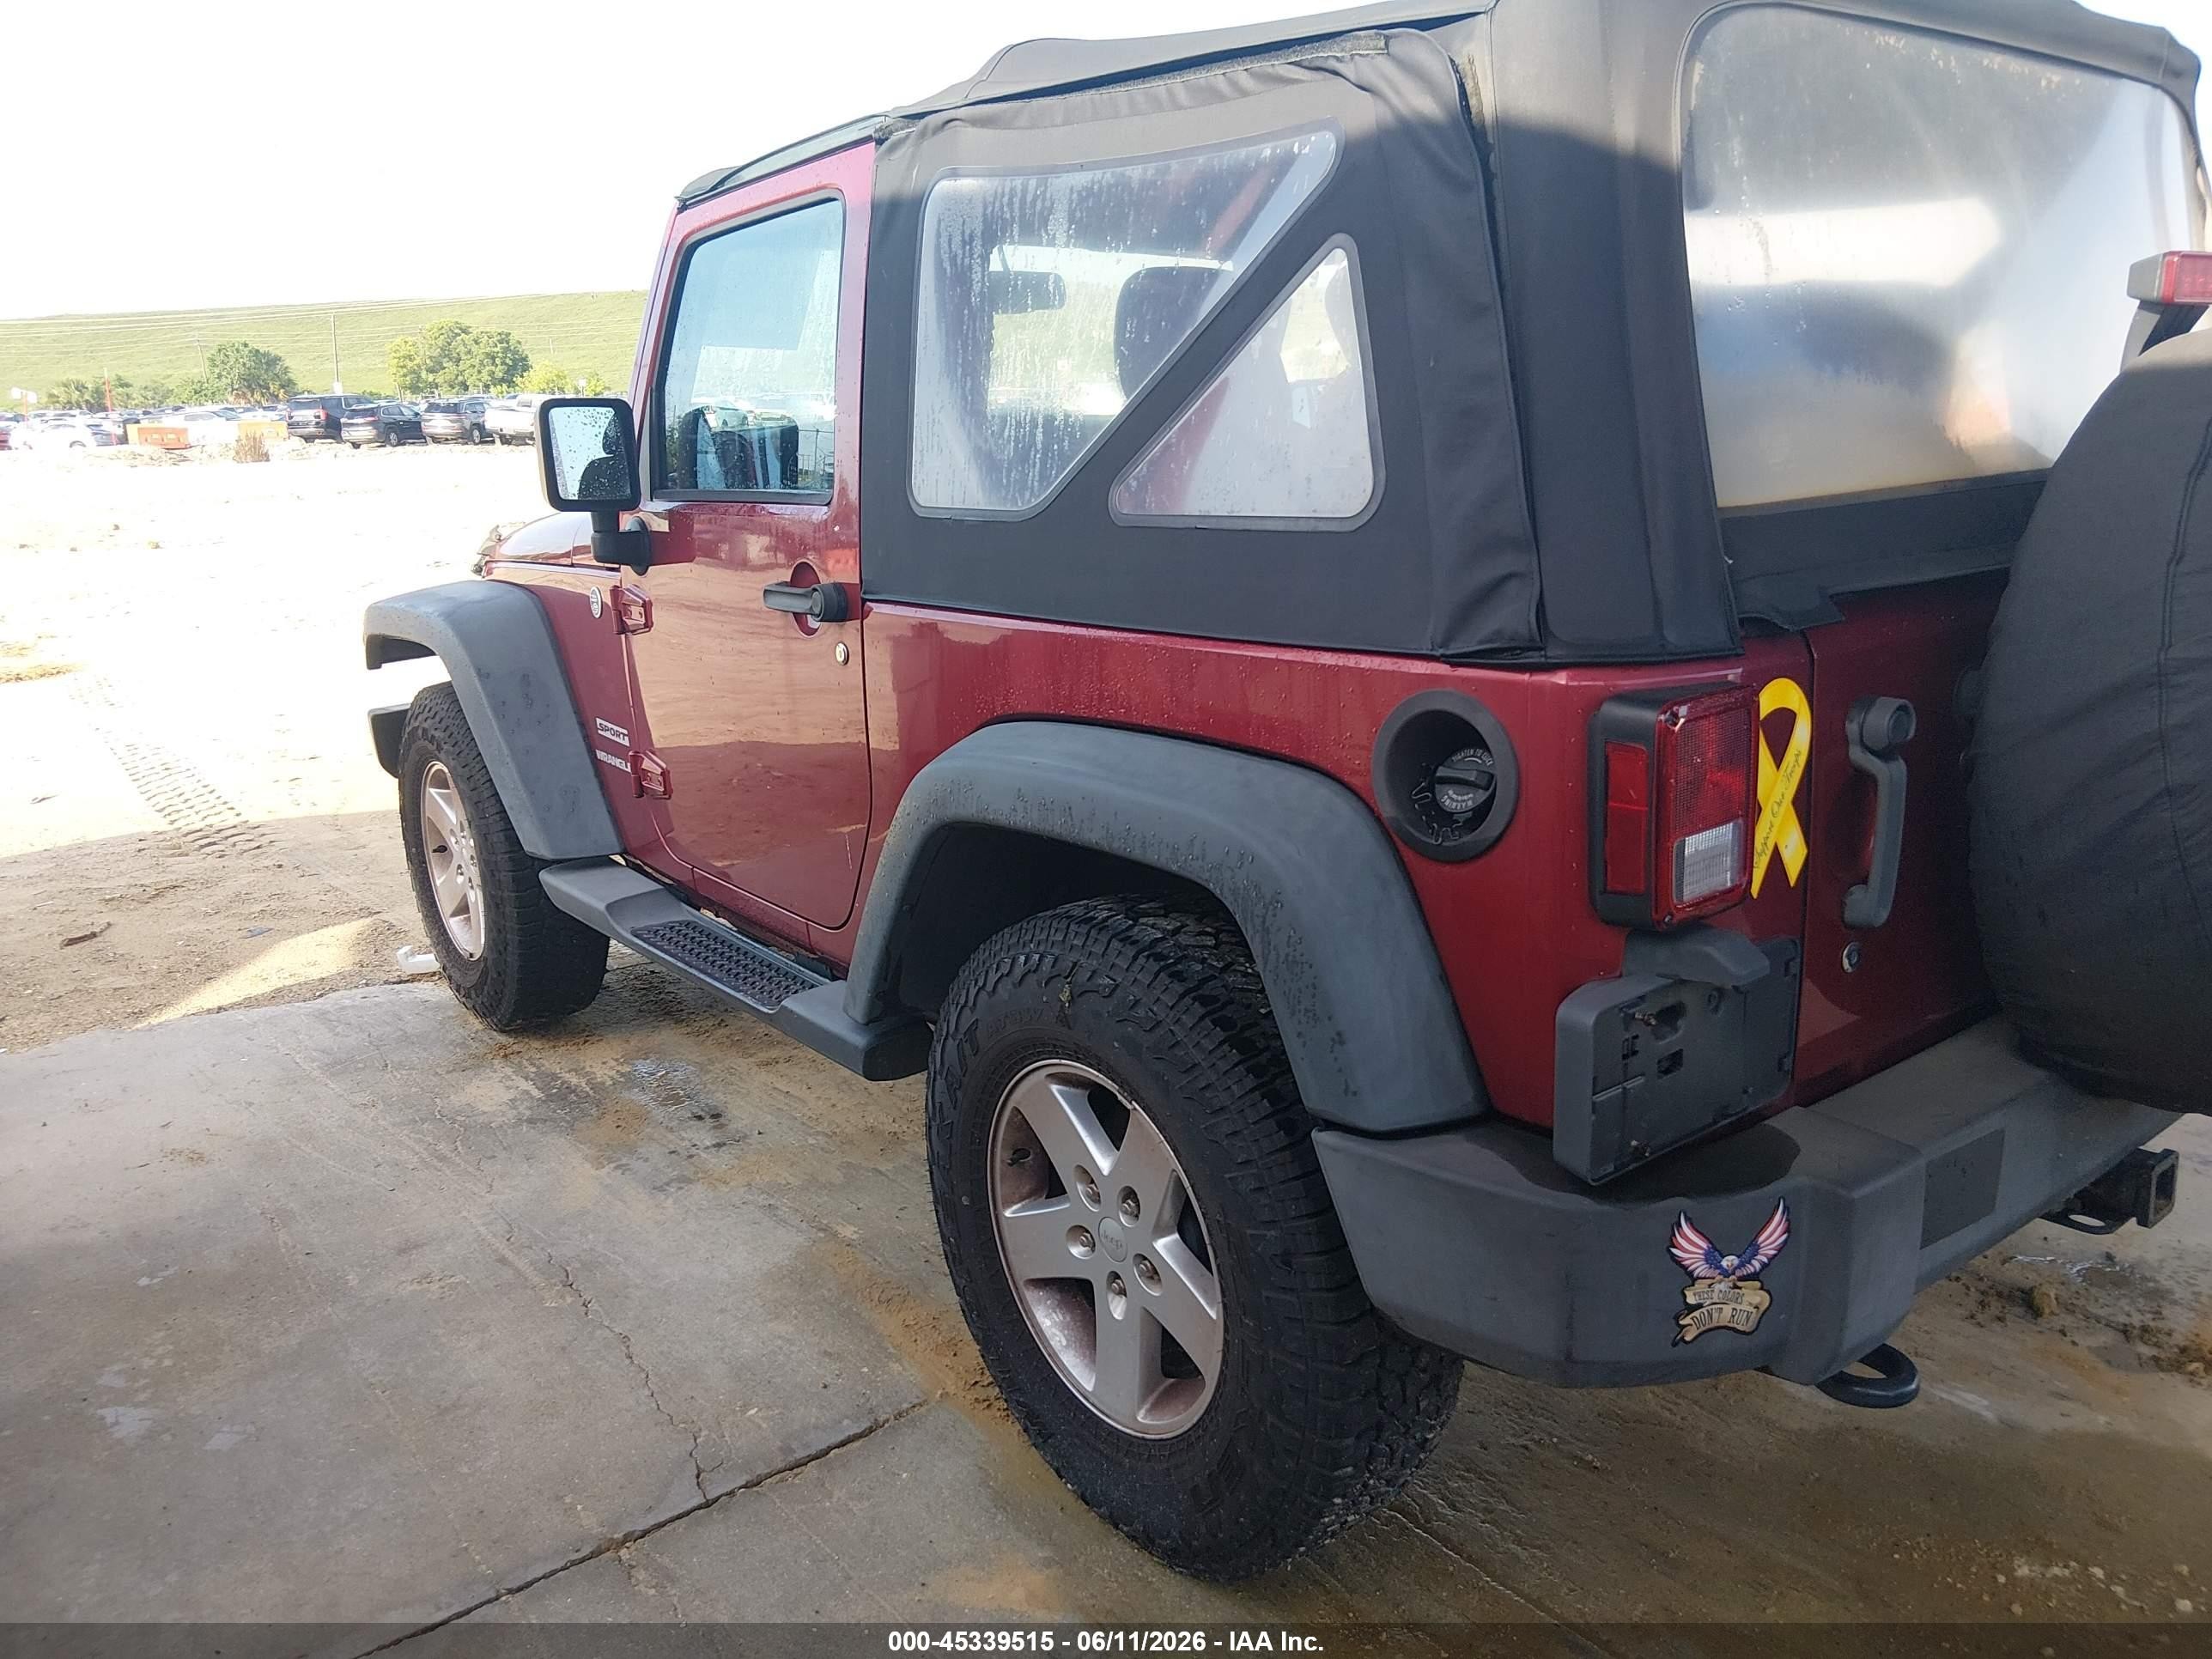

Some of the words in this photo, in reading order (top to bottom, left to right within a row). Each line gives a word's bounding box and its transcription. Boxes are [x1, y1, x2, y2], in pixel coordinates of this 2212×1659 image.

[597, 720, 629, 743] SPORT
[1753, 821, 1775, 869] Support
[1771, 791, 1785, 818] Our
[1101, 1230, 1124, 1250] Jeep
[1692, 1289, 1715, 1303] THESE
[1717, 1288, 1746, 1305] COLORS
[1691, 1307, 1723, 1330] DON'T
[1727, 1307, 1753, 1327] RUN
